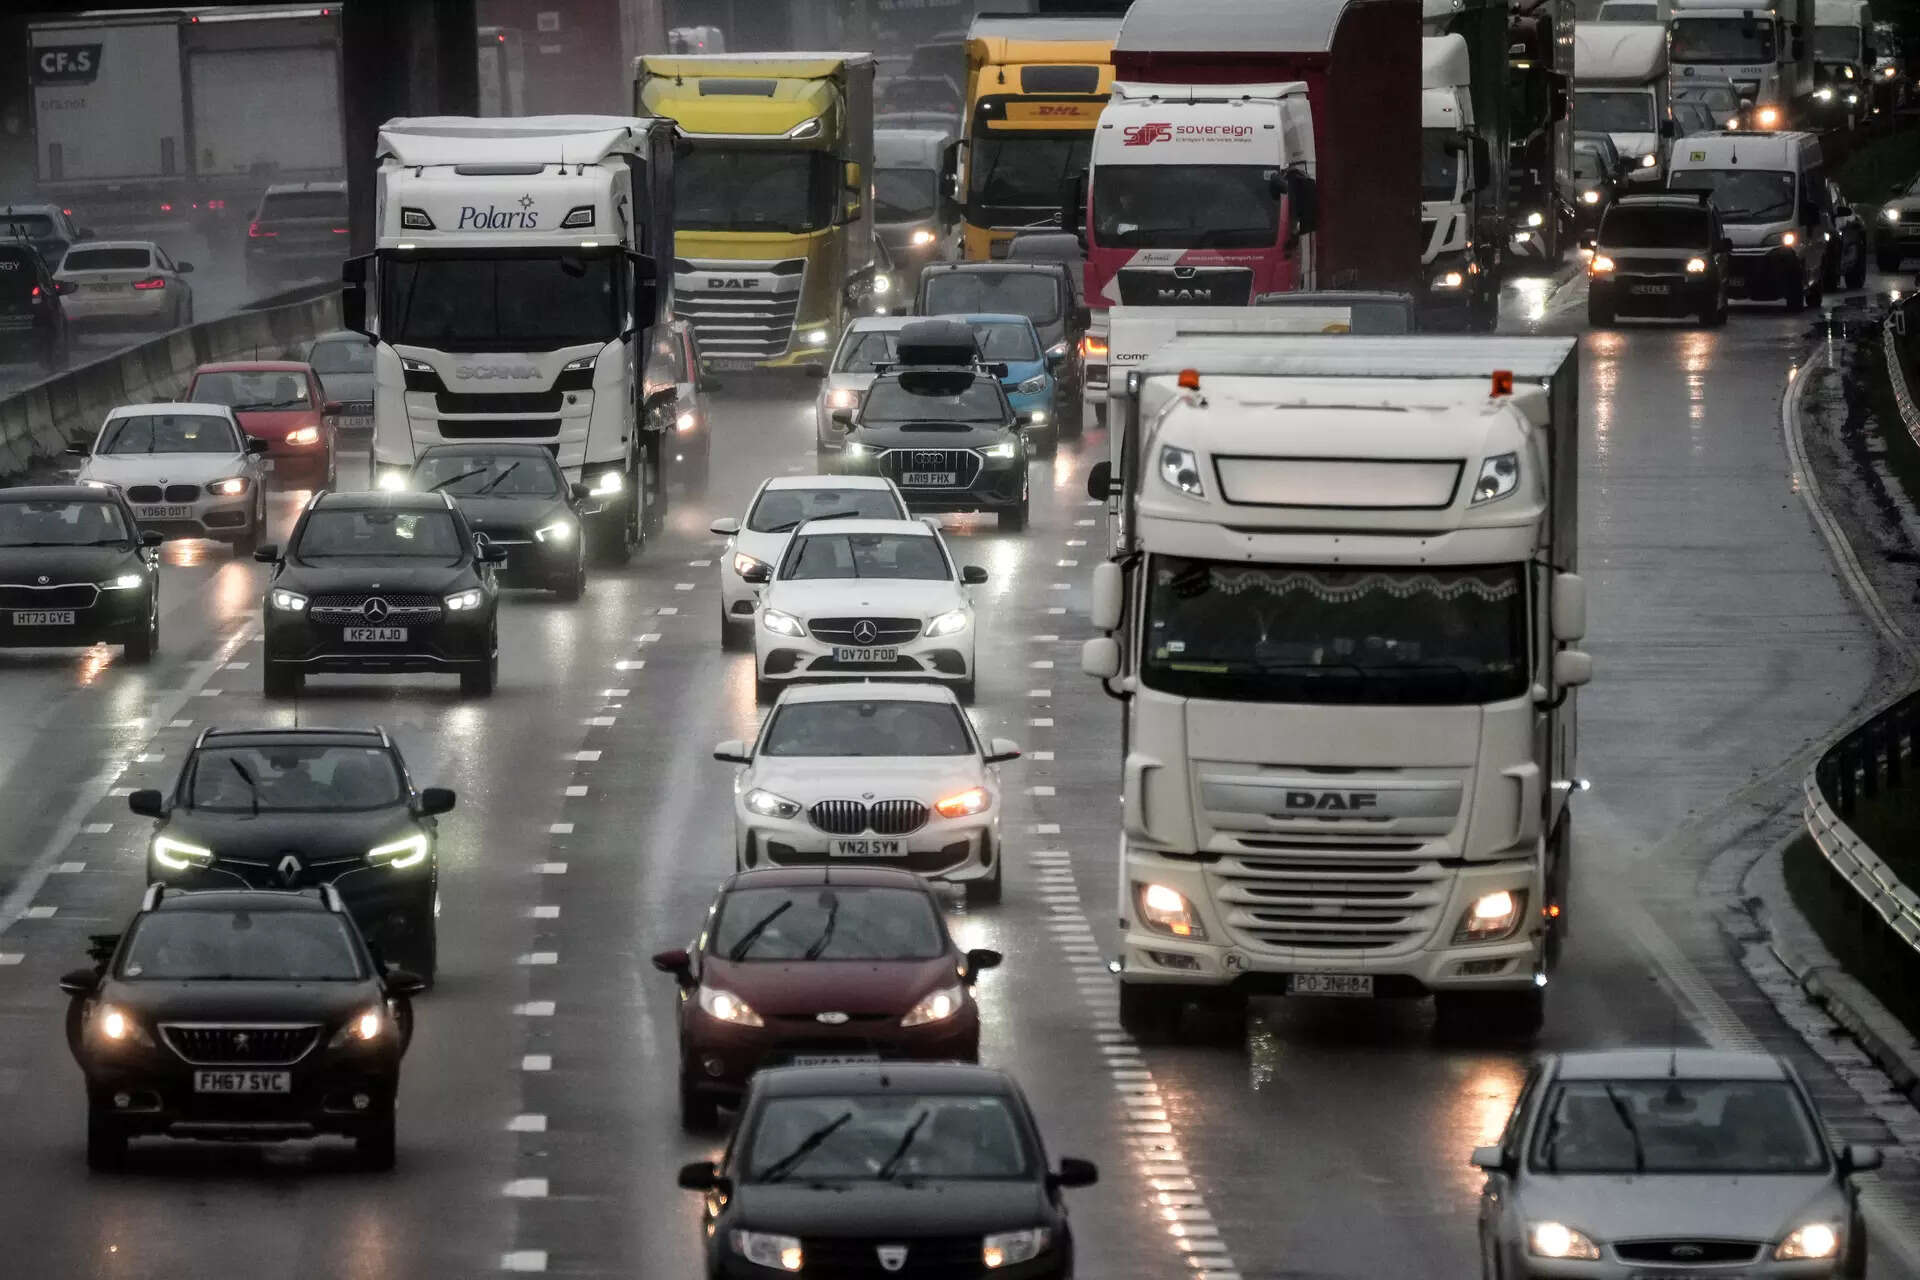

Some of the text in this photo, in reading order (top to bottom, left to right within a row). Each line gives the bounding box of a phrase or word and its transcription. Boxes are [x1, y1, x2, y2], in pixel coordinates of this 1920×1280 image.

[41, 51, 91, 73] CF&S
[1176, 125, 1253, 137] sovereign
[458, 205, 538, 229] Polaris
[708, 279, 759, 288] DAF
[1158, 289, 1212, 301] MAN
[456, 366, 544, 379] SCANIA
[18, 613, 46, 624] HT73
[351, 629, 376, 640] KF21
[841, 649, 871, 660] OV70
[1286, 792, 1377, 810] DAF
[838, 841, 898, 854] VN21 SYW
